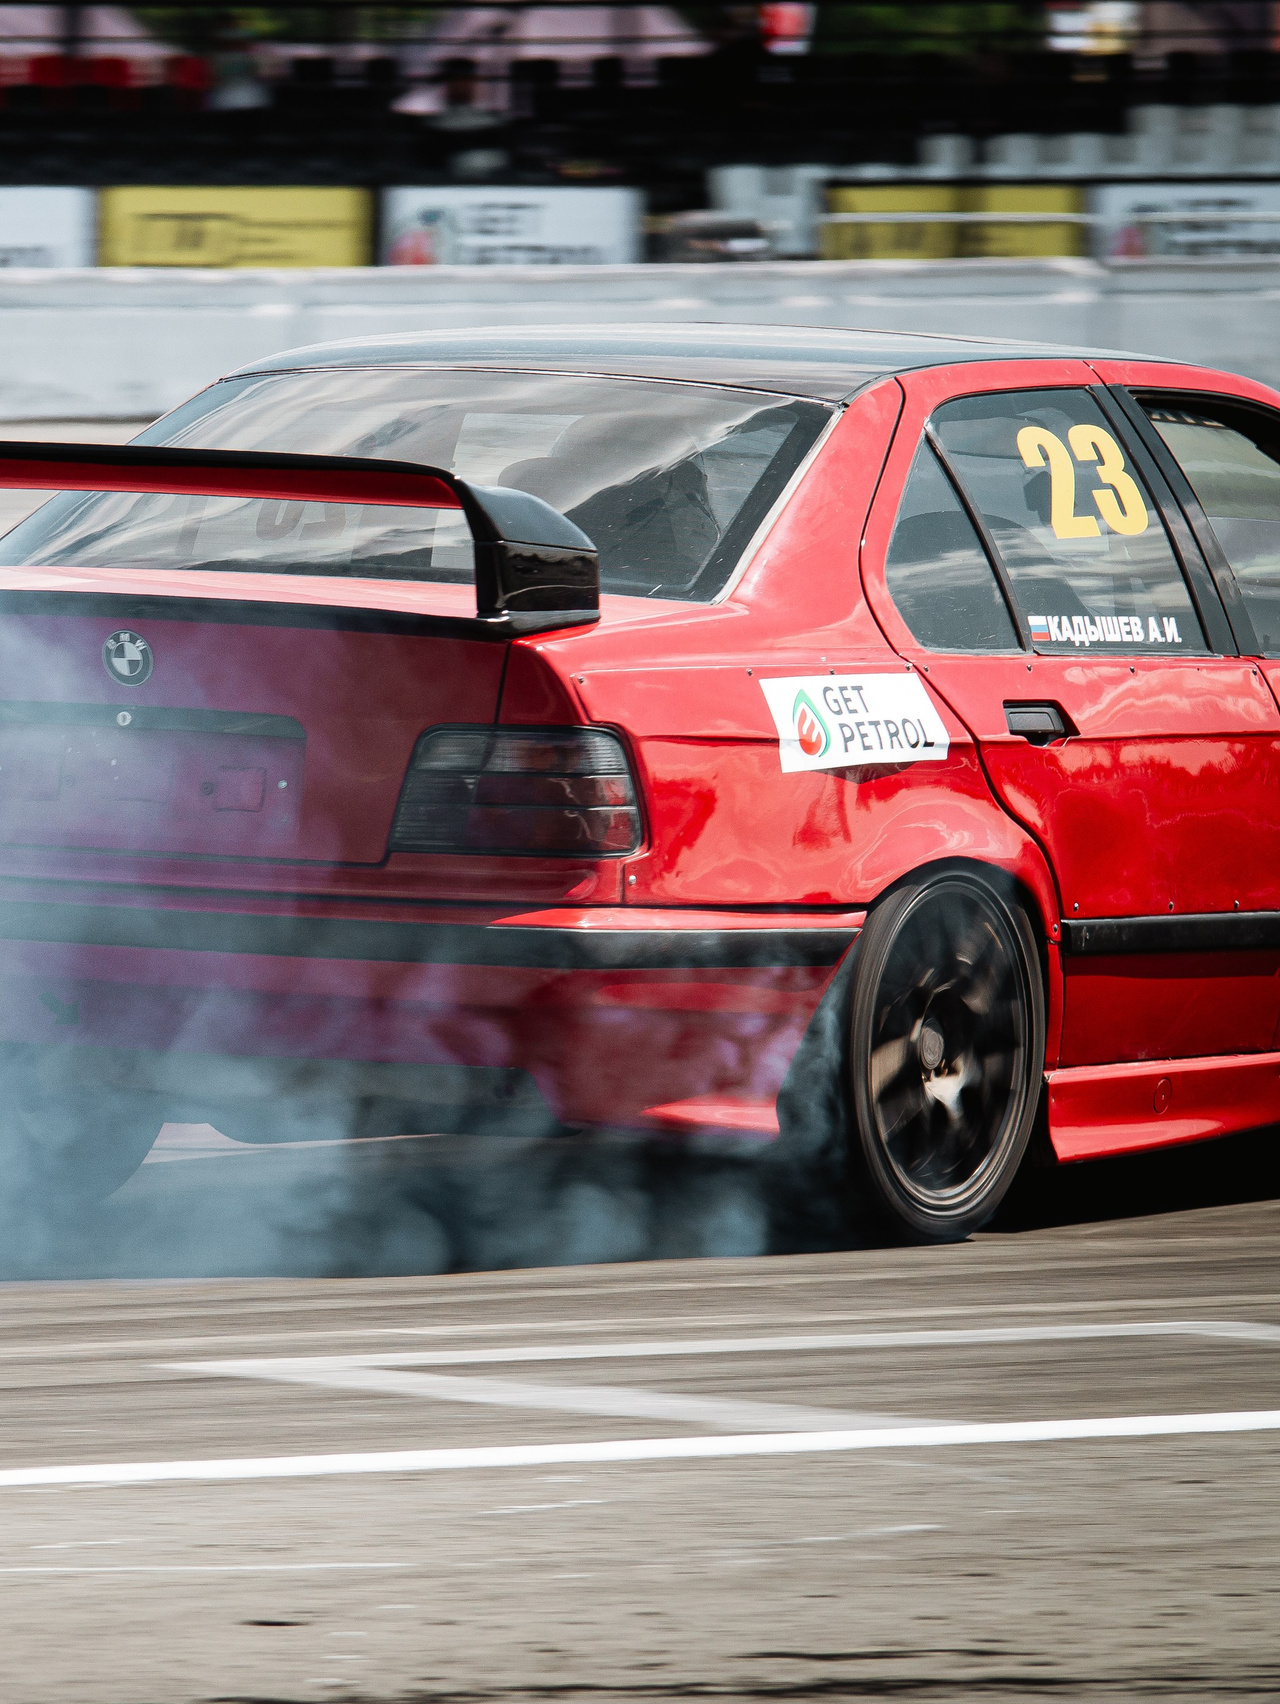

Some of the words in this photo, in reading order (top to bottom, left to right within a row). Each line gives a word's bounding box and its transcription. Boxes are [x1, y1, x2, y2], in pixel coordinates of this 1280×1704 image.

[1017, 424, 1148, 539] 23
[105, 632, 147, 651] BMW
[1047, 616, 1145, 646] КАДЫШЕВ
[1148, 616, 1182, 643] А.И.
[822, 685, 870, 716] GET
[838, 718, 935, 752] PETROL
